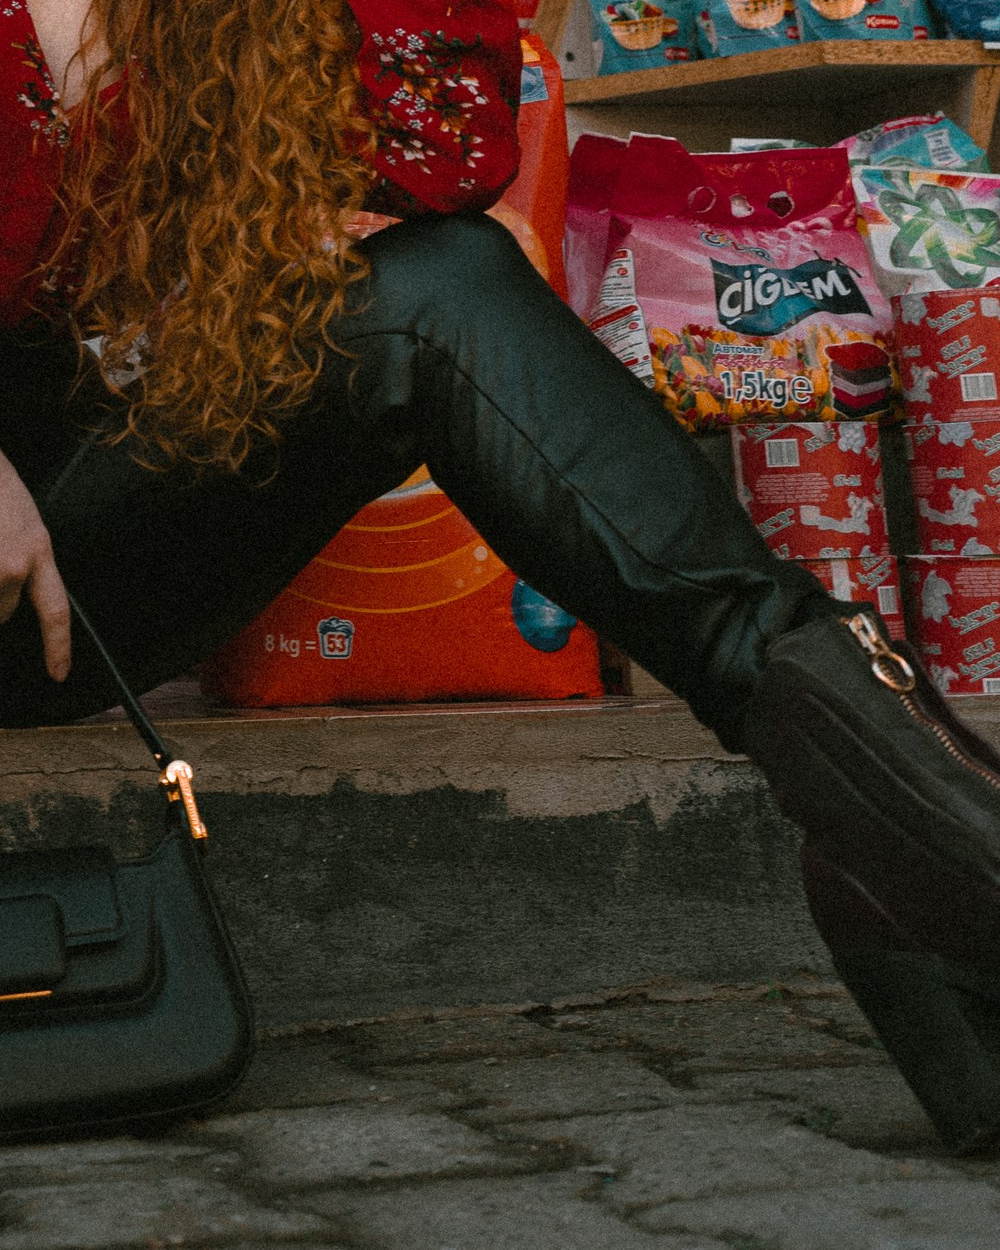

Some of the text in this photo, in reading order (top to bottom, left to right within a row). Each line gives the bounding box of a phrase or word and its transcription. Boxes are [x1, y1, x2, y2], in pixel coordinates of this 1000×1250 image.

[940, 335, 972, 361] SELF
[720, 369, 788, 409] 1,5kg
[265, 634, 275, 652] 8
[280, 634, 301, 658] kg
[326, 635, 347, 653] 53
[963, 637, 995, 662] SELF
